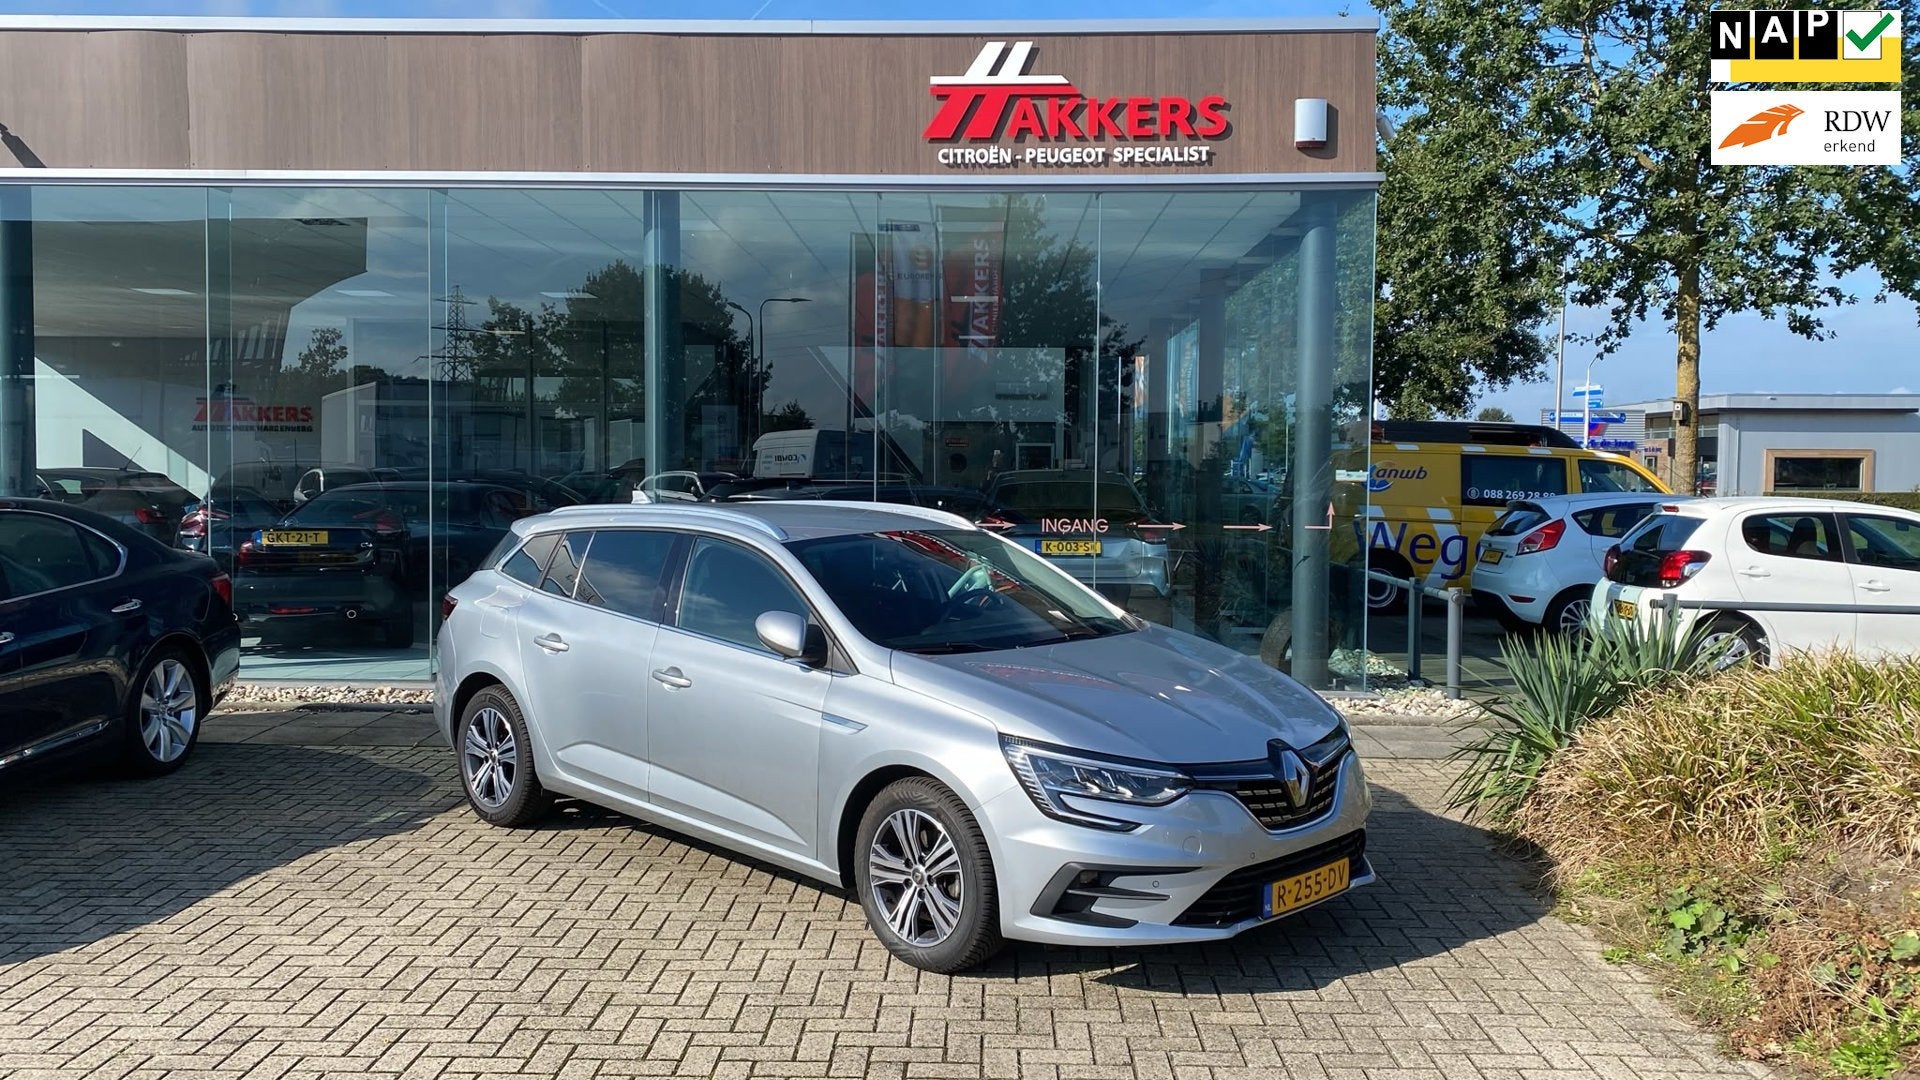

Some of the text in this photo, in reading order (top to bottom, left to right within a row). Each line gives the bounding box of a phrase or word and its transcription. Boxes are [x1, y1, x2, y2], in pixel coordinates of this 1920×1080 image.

[938, 145, 1012, 164] CITROËN
[1025, 147, 1106, 163] PEUGEOT
[1113, 146, 1210, 163] SPECIALIST
[1376, 466, 1428, 480] anwb
[1483, 489, 1504, 499] 088
[1505, 490, 1525, 500] 269
[1041, 518, 1109, 533] INGANG
[267, 532, 320, 543] GKT-21-T
[1353, 519, 1482, 580] Weg
[1277, 863, 1346, 909] R-255-DV
